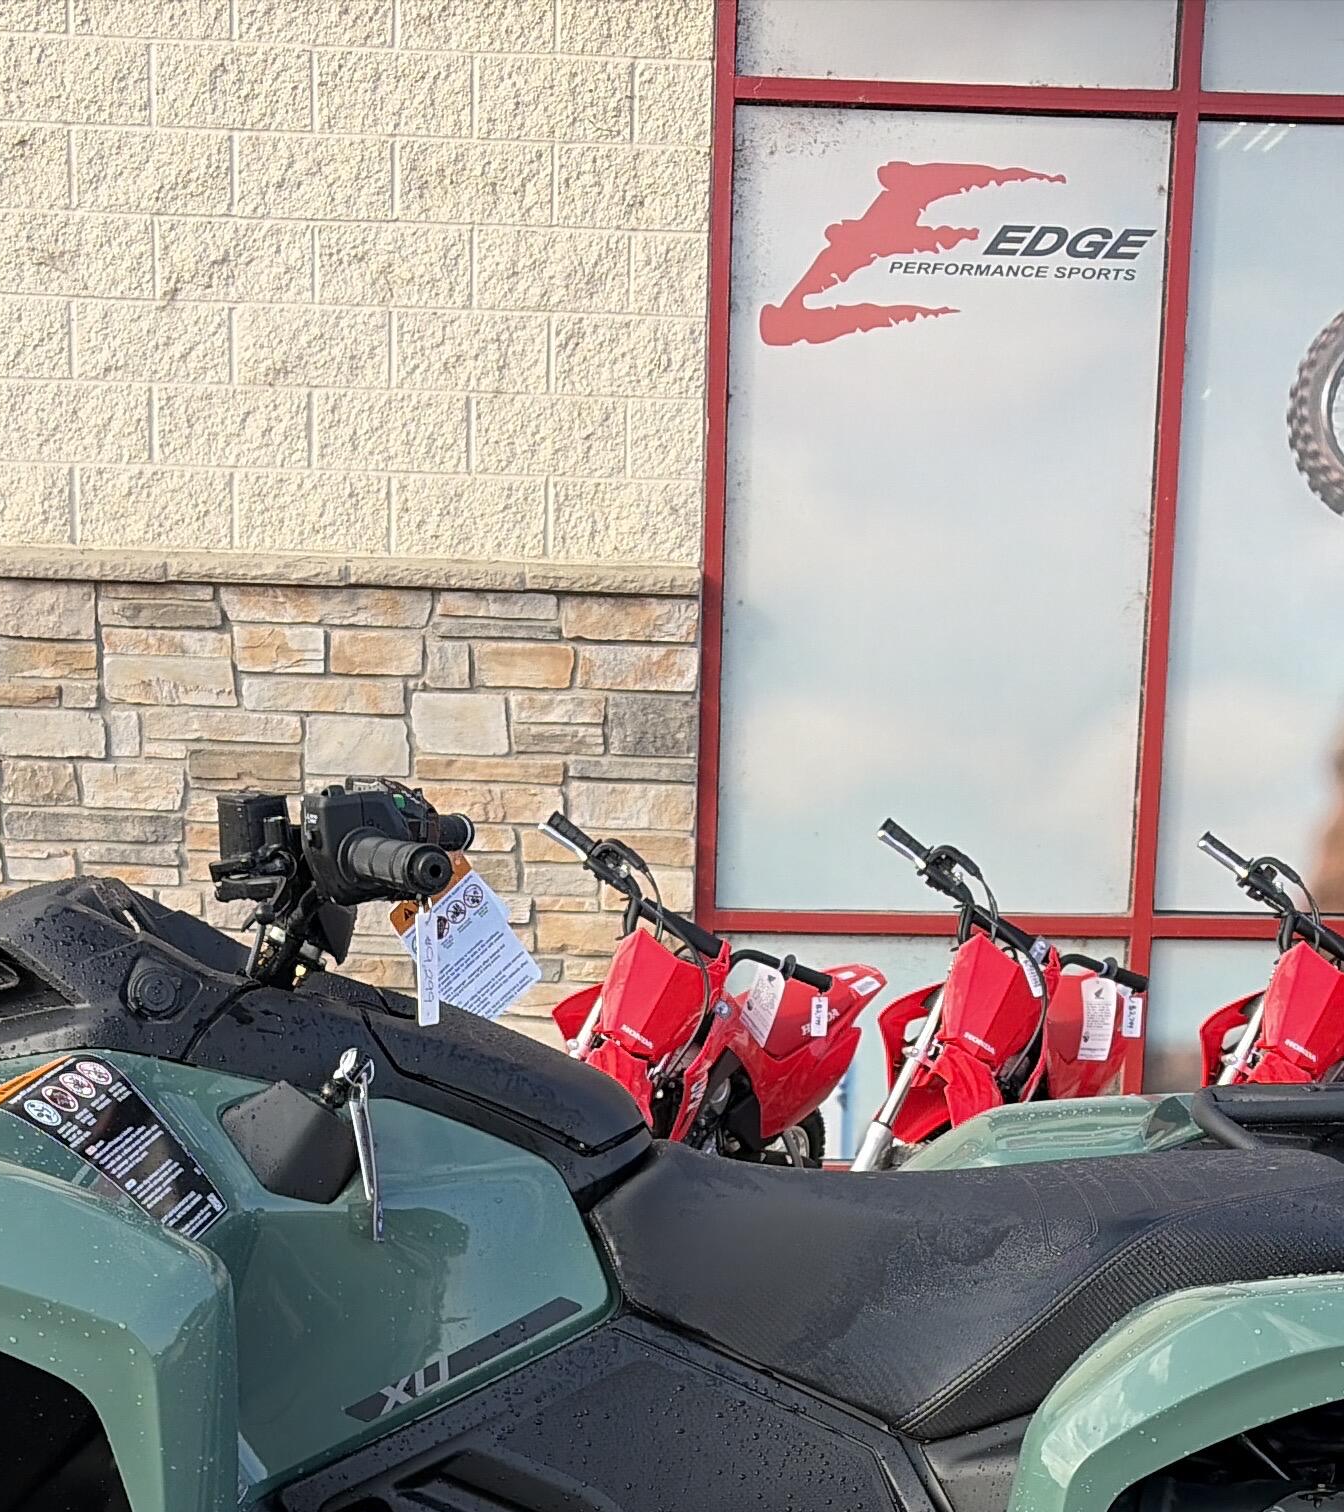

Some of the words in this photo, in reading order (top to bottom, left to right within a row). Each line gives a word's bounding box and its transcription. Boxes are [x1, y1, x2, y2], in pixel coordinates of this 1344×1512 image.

[982, 224, 1157, 260] EDGE
[888, 261, 1050, 279] PERFORMANCE
[1053, 265, 1137, 281] SPORTS
[621, 1024, 654, 1050] HONDA
[1284, 1038, 1317, 1063] HONDA
